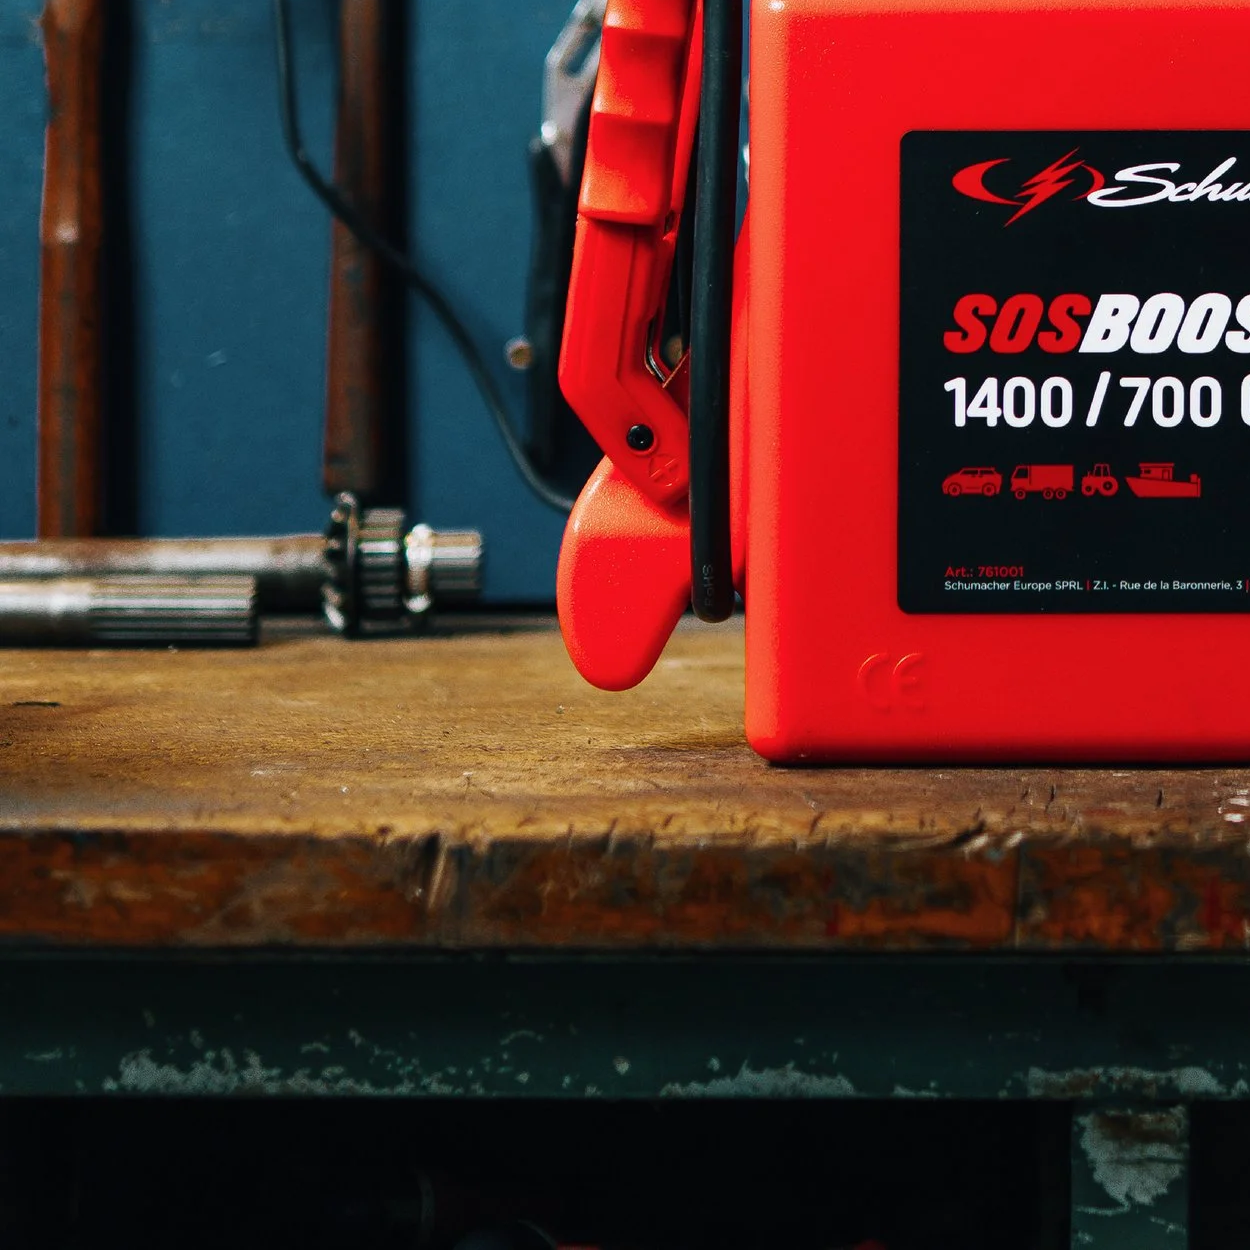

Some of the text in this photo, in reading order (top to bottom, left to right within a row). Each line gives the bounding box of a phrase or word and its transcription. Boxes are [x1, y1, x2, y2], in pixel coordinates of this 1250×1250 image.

[943, 376, 1074, 428] 1400
[1119, 376, 1223, 428] 700
[944, 566, 1024, 578] Art.: 761001
[944, 580, 1011, 591] Schumacher
[1013, 580, 1052, 592] Europe
[1055, 580, 1083, 591] SPRL
[1093, 580, 1109, 591] Z.I.
[1120, 580, 1141, 591] Rue
[1143, 580, 1158, 591] de
[1160, 580, 1170, 591] la
[1172, 580, 1233, 592] Baronnerie,
[1236, 580, 1243, 591] 3
